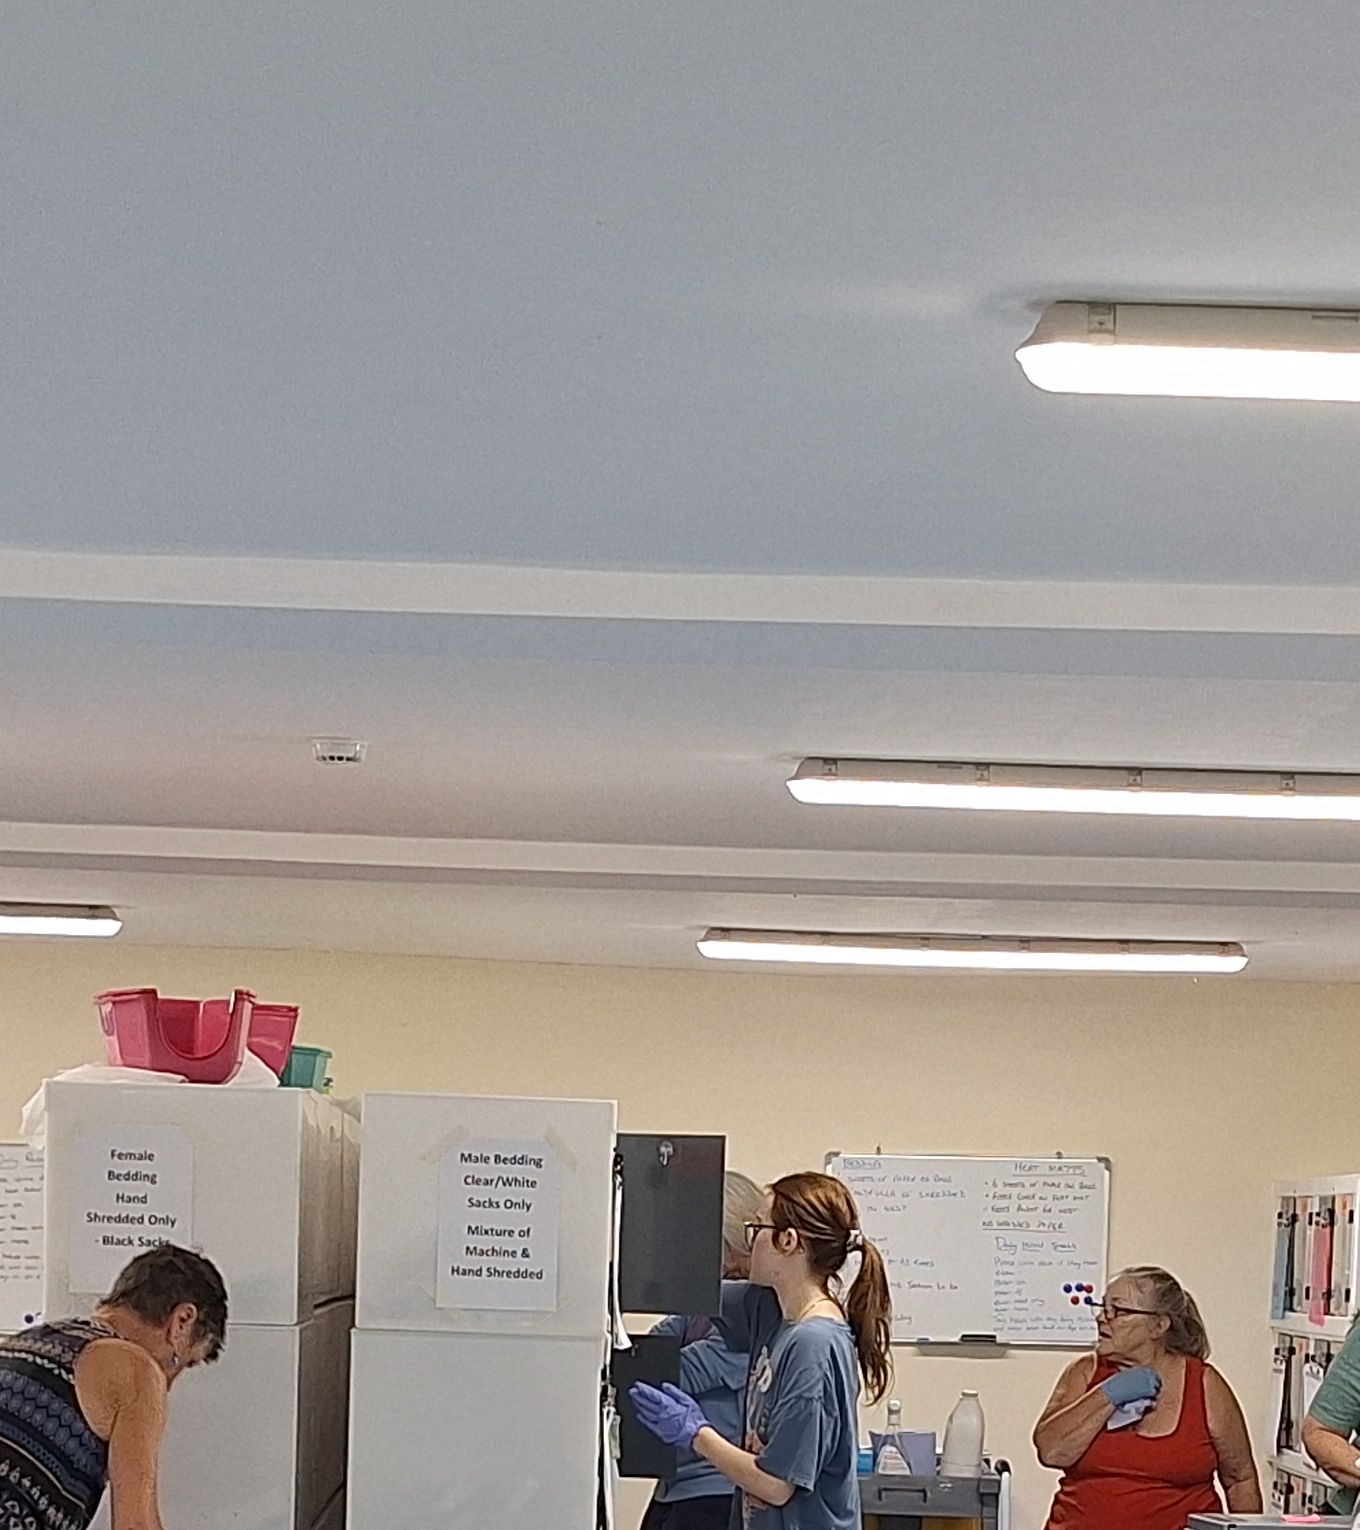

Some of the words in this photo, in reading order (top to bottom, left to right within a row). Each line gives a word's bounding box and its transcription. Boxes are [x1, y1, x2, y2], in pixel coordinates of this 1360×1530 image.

[110, 1148, 155, 1162] Female
[459, 1152, 491, 1165] Male
[493, 1153, 544, 1169] Bedding
[107, 1169, 158, 1185] Bedding
[462, 1174, 538, 1189] Clear/White
[115, 1192, 148, 1204] Hand
[466, 1196, 500, 1210] Sacks
[503, 1198, 533, 1213] Only
[85, 1211, 145, 1225] Shredded
[147, 1213, 178, 1228] Only
[466, 1224, 515, 1238] Mixture
[517, 1226, 532, 1239] of
[101, 1234, 134, 1247] Black
[464, 1245, 518, 1259] Machine
[520, 1247, 531, 1259] &
[450, 1265, 483, 1278] Hand
[485, 1266, 544, 1281] Shredded
